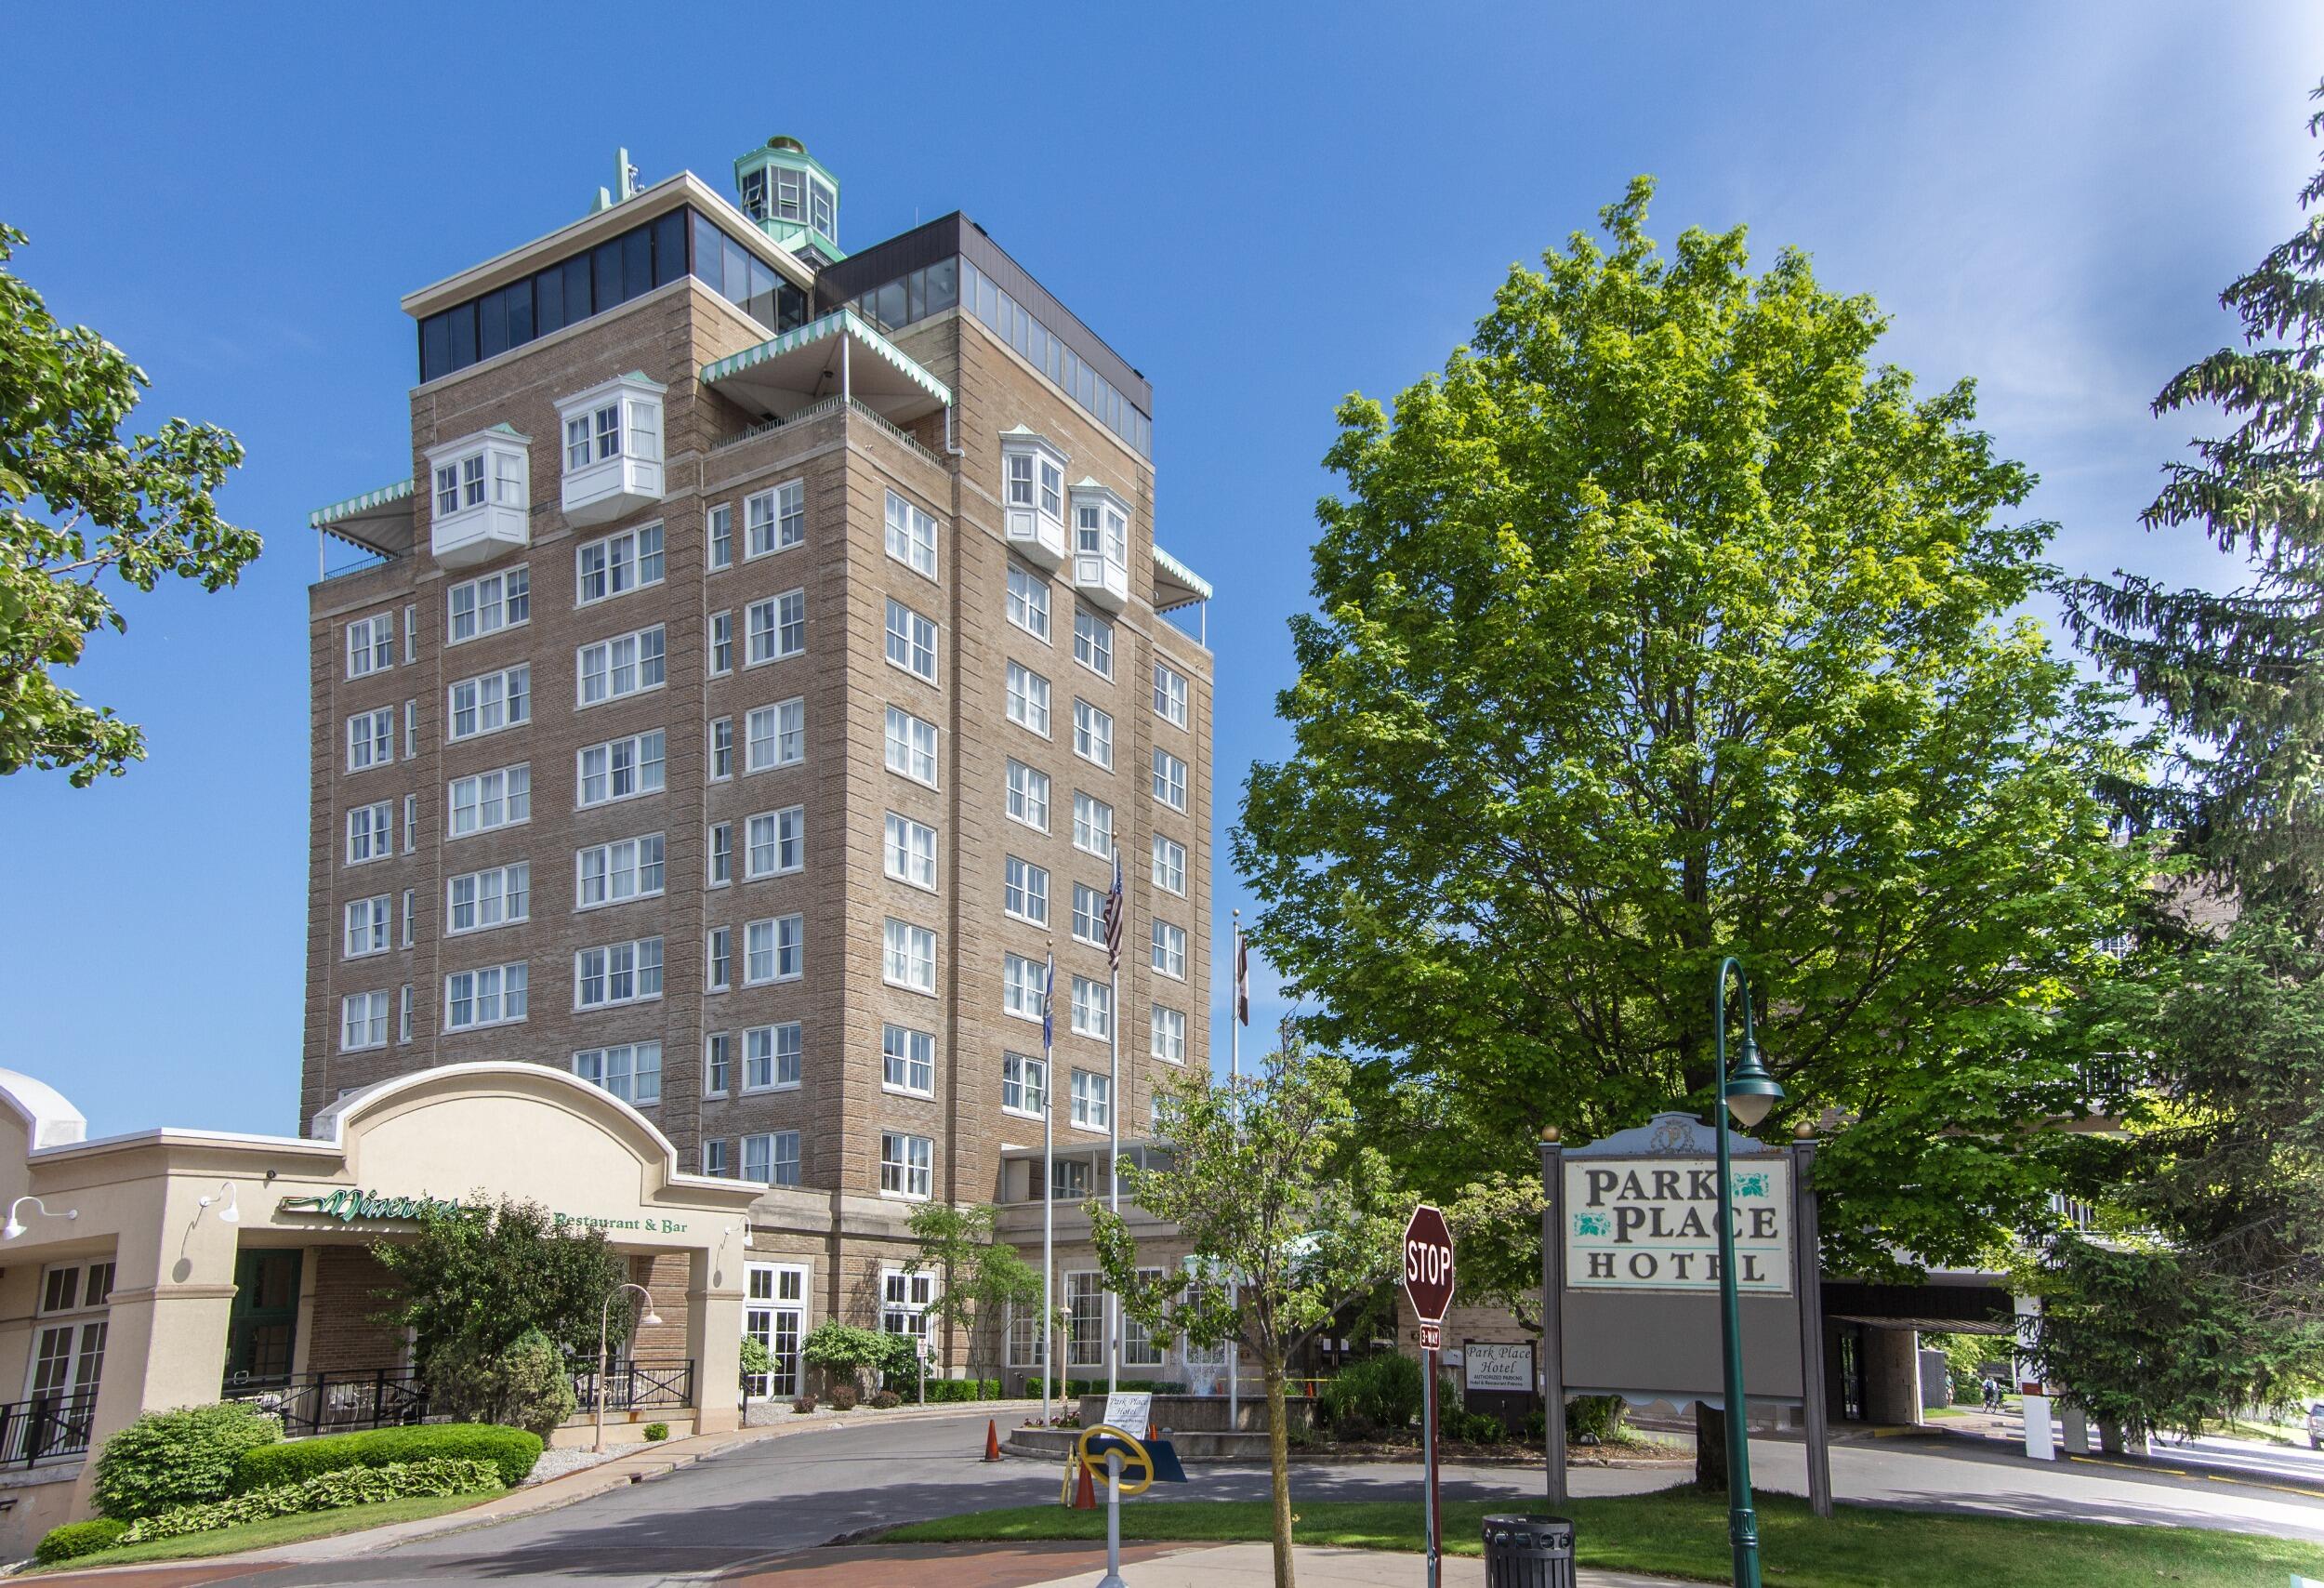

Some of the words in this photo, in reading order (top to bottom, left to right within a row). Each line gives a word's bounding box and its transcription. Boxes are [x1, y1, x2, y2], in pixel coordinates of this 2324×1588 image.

[1586, 1170, 1718, 1207] PARK
[553, 1211, 640, 1230] Restaurant
[645, 1218, 657, 1231] &
[661, 1219, 688, 1234] Bar
[1407, 1239, 1451, 1286] STOP
[1421, 1330, 1438, 1344] 3-WAY
[1467, 1345, 1497, 1360] Park
[1499, 1345, 1531, 1358] Place
[1481, 1361, 1517, 1373] Hotel
[1110, 1397, 1128, 1407] Park
